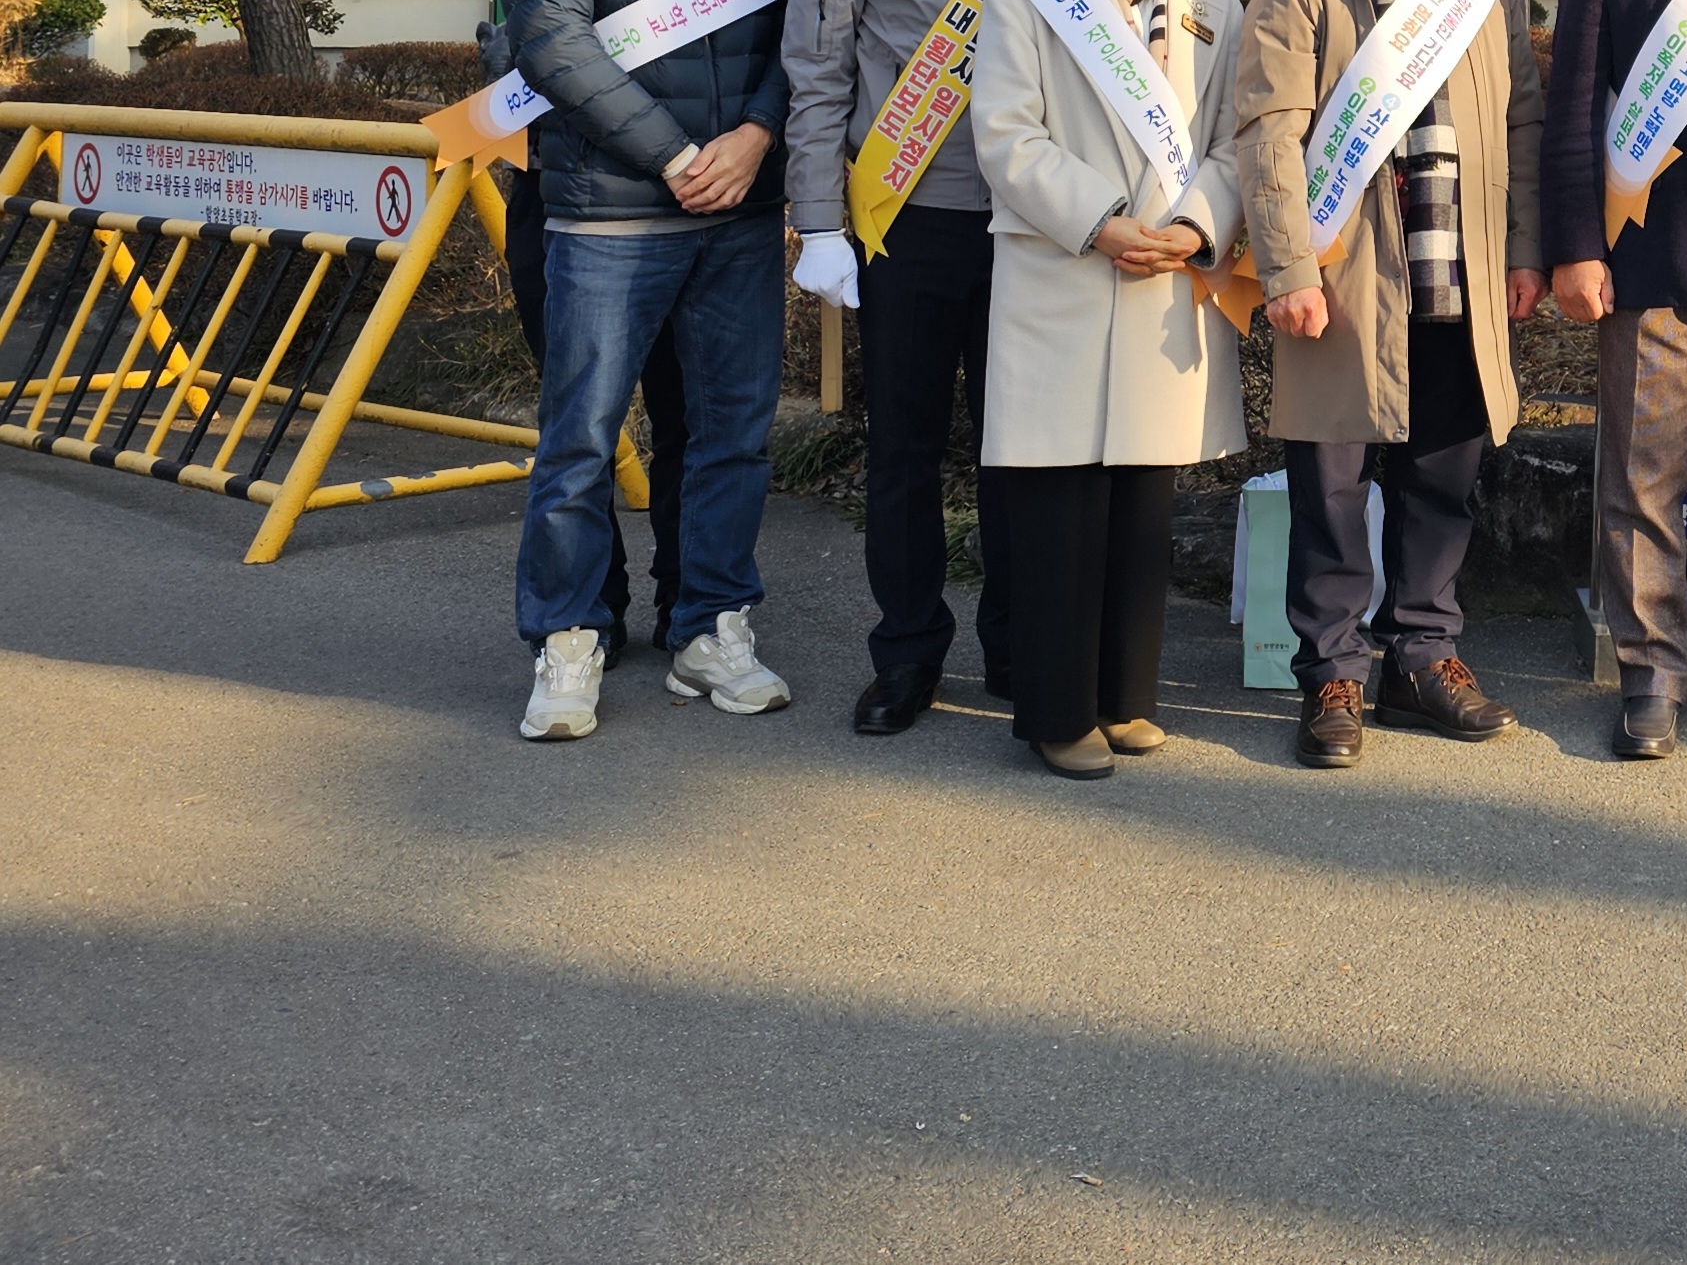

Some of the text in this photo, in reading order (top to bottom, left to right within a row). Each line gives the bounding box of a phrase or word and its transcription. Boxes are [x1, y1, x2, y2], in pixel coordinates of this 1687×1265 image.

[647, 2, 688, 39] 학교
[944, 2, 977, 34] 내
[877, 34, 957, 142] 횡단보도
[1638, 33, 1687, 101] 이쪽저쪽
[1661, 77, 1687, 109] 예방
[883, 86, 961, 193] 일시정지
[1143, 104, 1190, 187] 친구에겐
[1323, 92, 1367, 163] 이쪽저쪽
[1360, 108, 1390, 139] 사고
[1613, 101, 1644, 151] 살펴요
[1629, 106, 1665, 162] 노력해요
[116, 142, 257, 174] 이곳은 학생들의 교육공간입니다.
[1344, 137, 1369, 169] 예방
[115, 171, 358, 213] 안전한 교육활동을 위하여 통행을 삼가시기를 바랍니다.
[1307, 165, 1329, 207] 살펴
[1313, 168, 1348, 226] 노력해요
